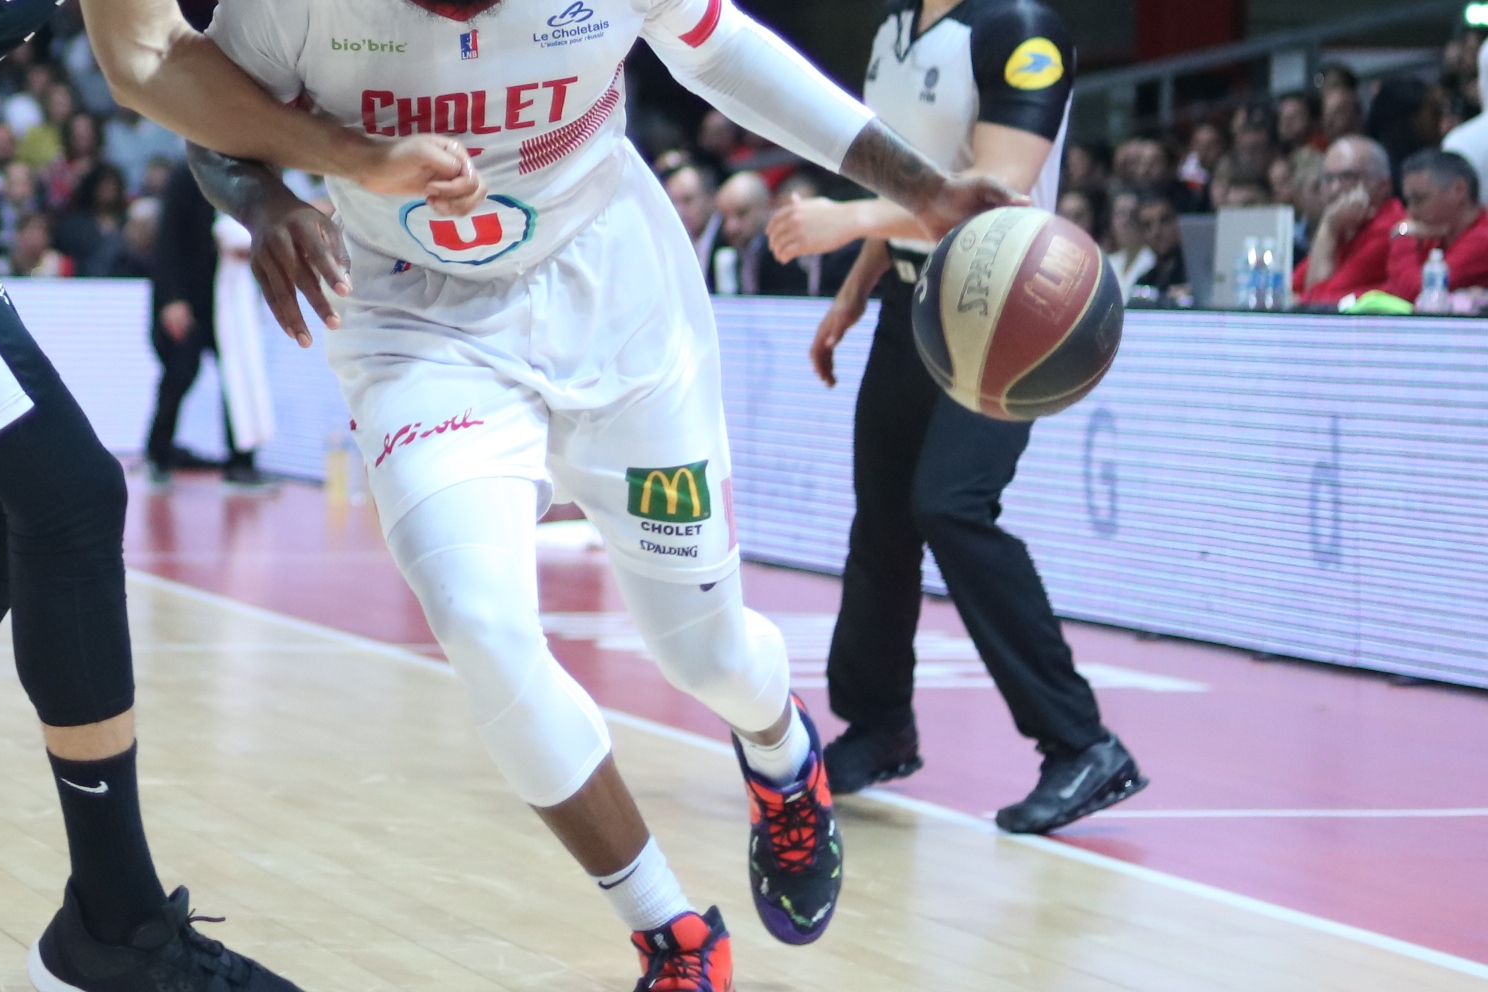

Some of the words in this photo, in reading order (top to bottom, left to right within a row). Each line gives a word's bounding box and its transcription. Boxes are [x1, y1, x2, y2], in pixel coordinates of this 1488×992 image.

[532, 31, 549, 44] Le
[551, 19, 610, 40] Choletais
[361, 76, 579, 138] CHOLET
[428, 211, 503, 252] U
[640, 521, 703, 537] CHOLET
[639, 539, 698, 558] SPALDING
